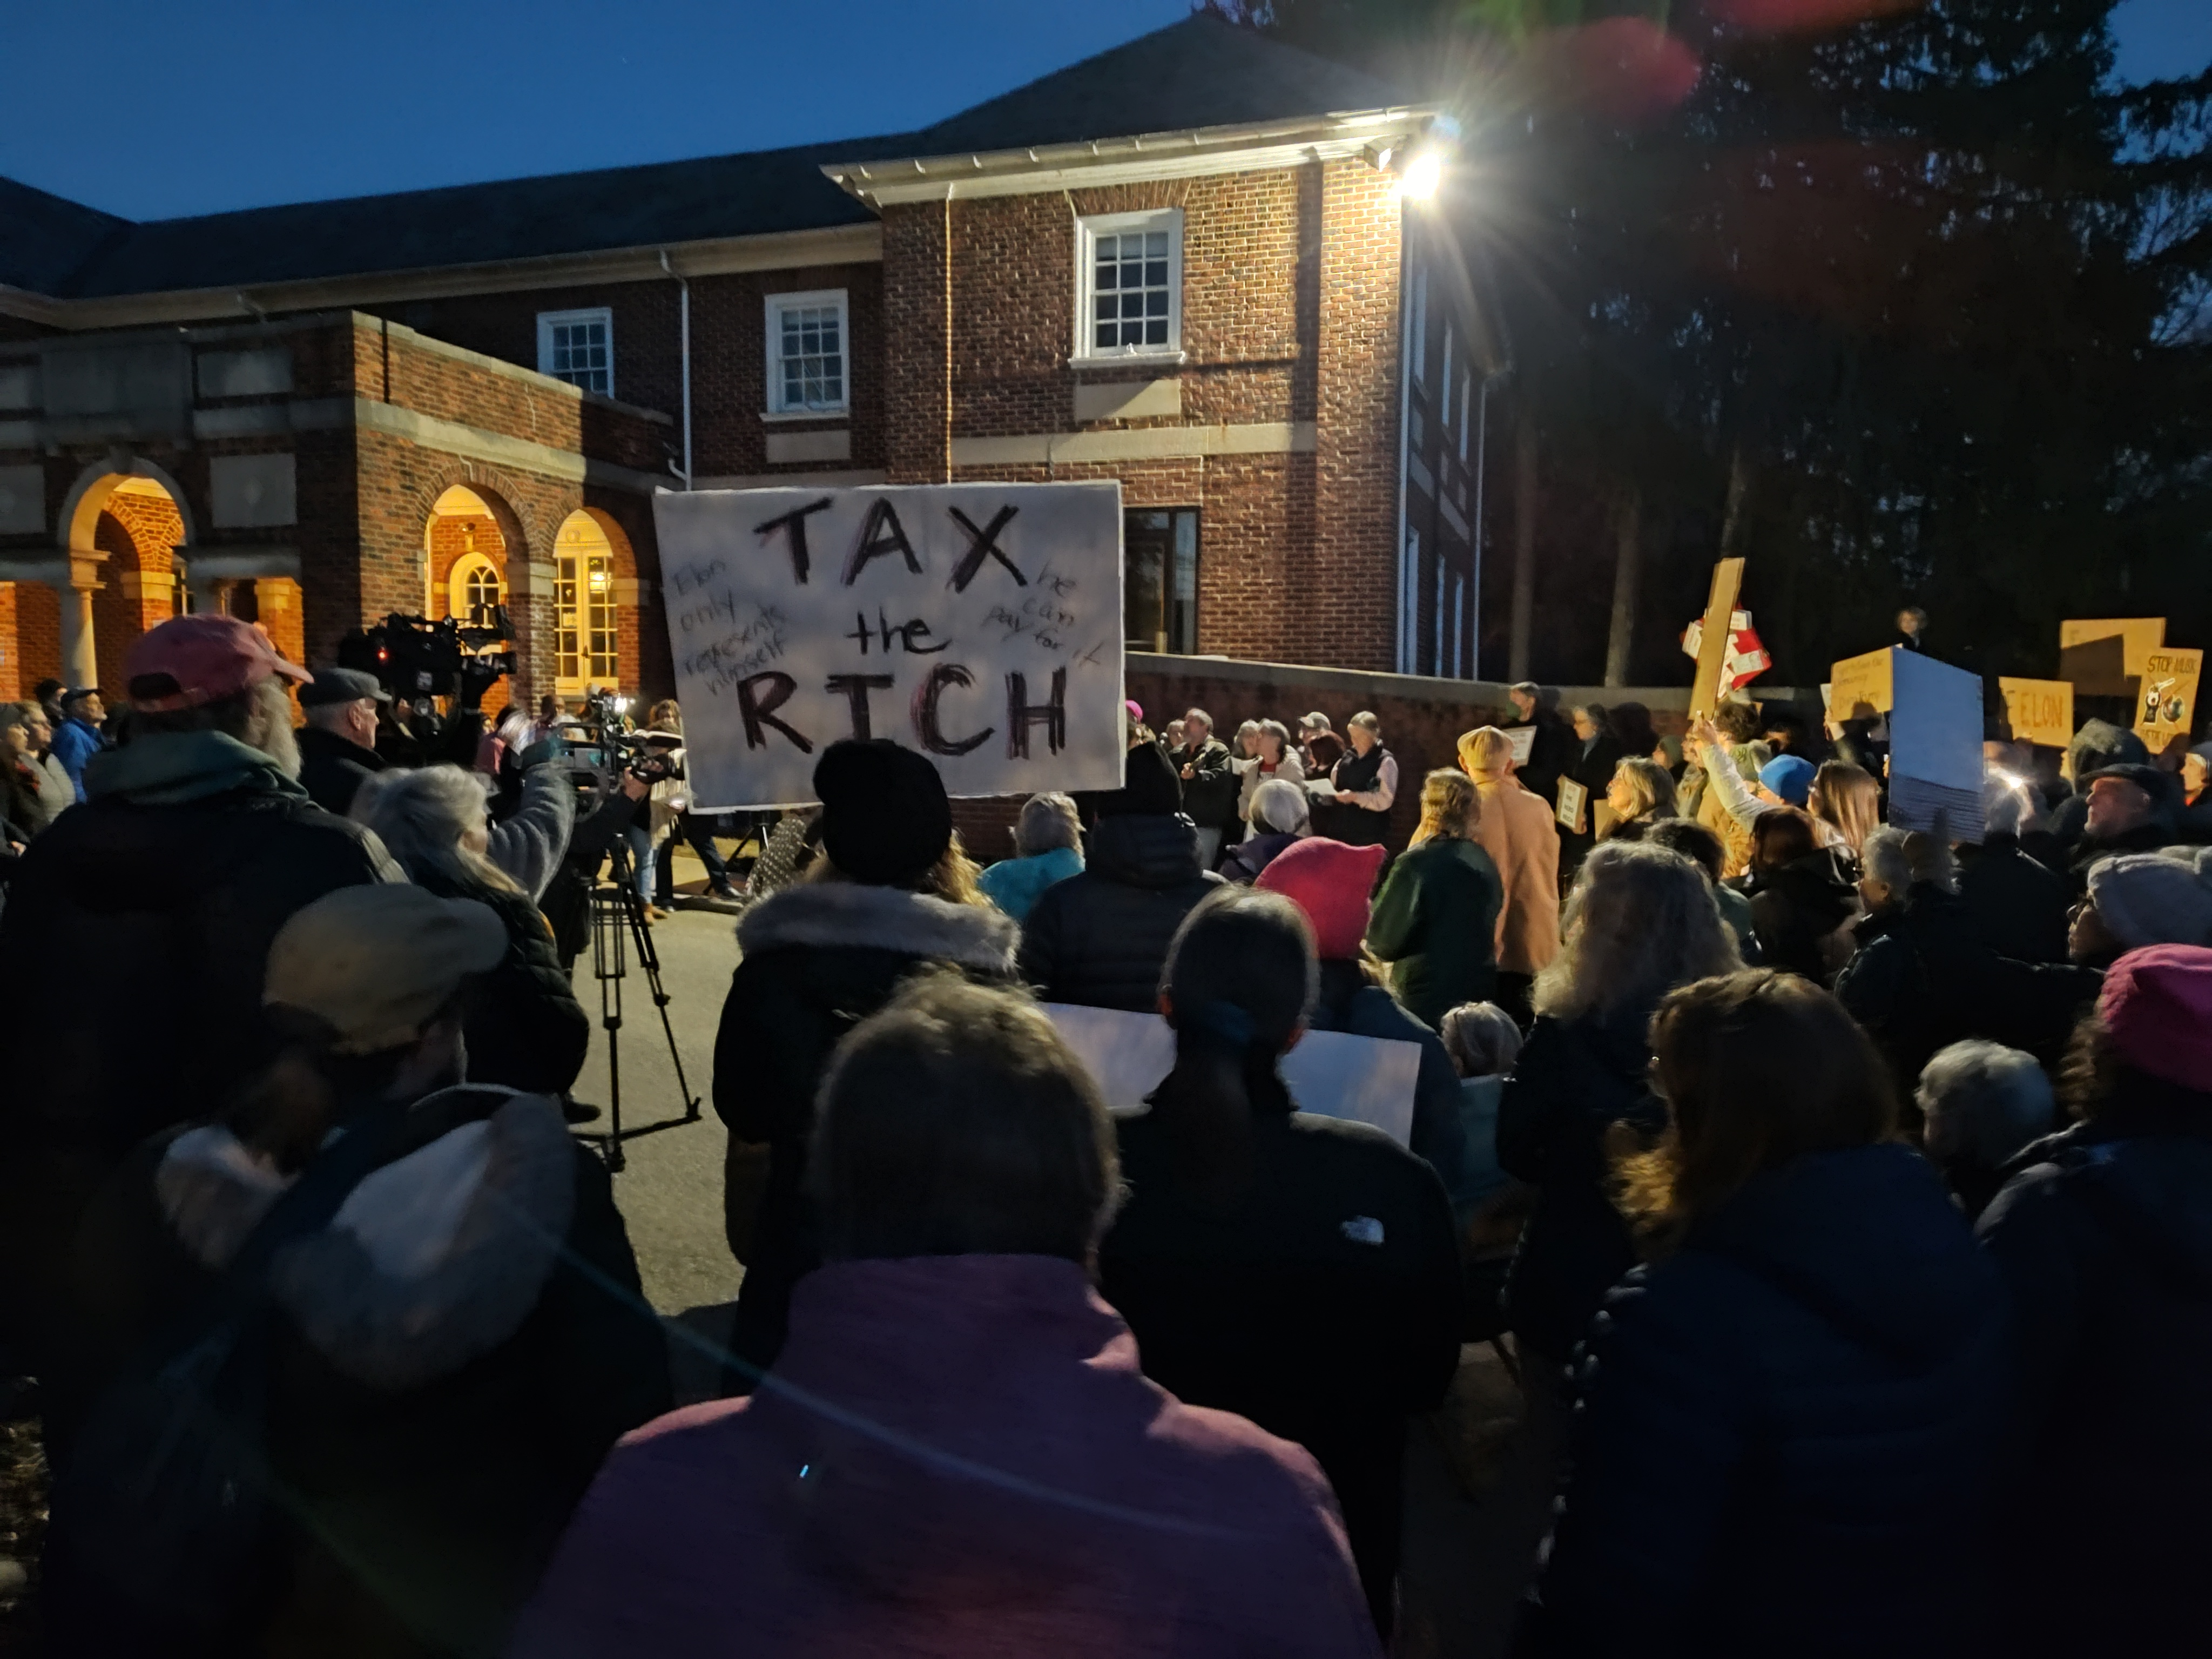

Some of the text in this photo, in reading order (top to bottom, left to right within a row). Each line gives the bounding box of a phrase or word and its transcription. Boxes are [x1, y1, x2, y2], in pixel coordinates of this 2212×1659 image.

[752, 497, 1028, 594] TAX
[672, 559, 727, 596] Elon
[680, 588, 736, 632] only
[846, 606, 953, 655] the
[1022, 595, 1075, 627] can
[2147, 655, 2172, 673] STOP
[736, 662, 1067, 760] RICH
